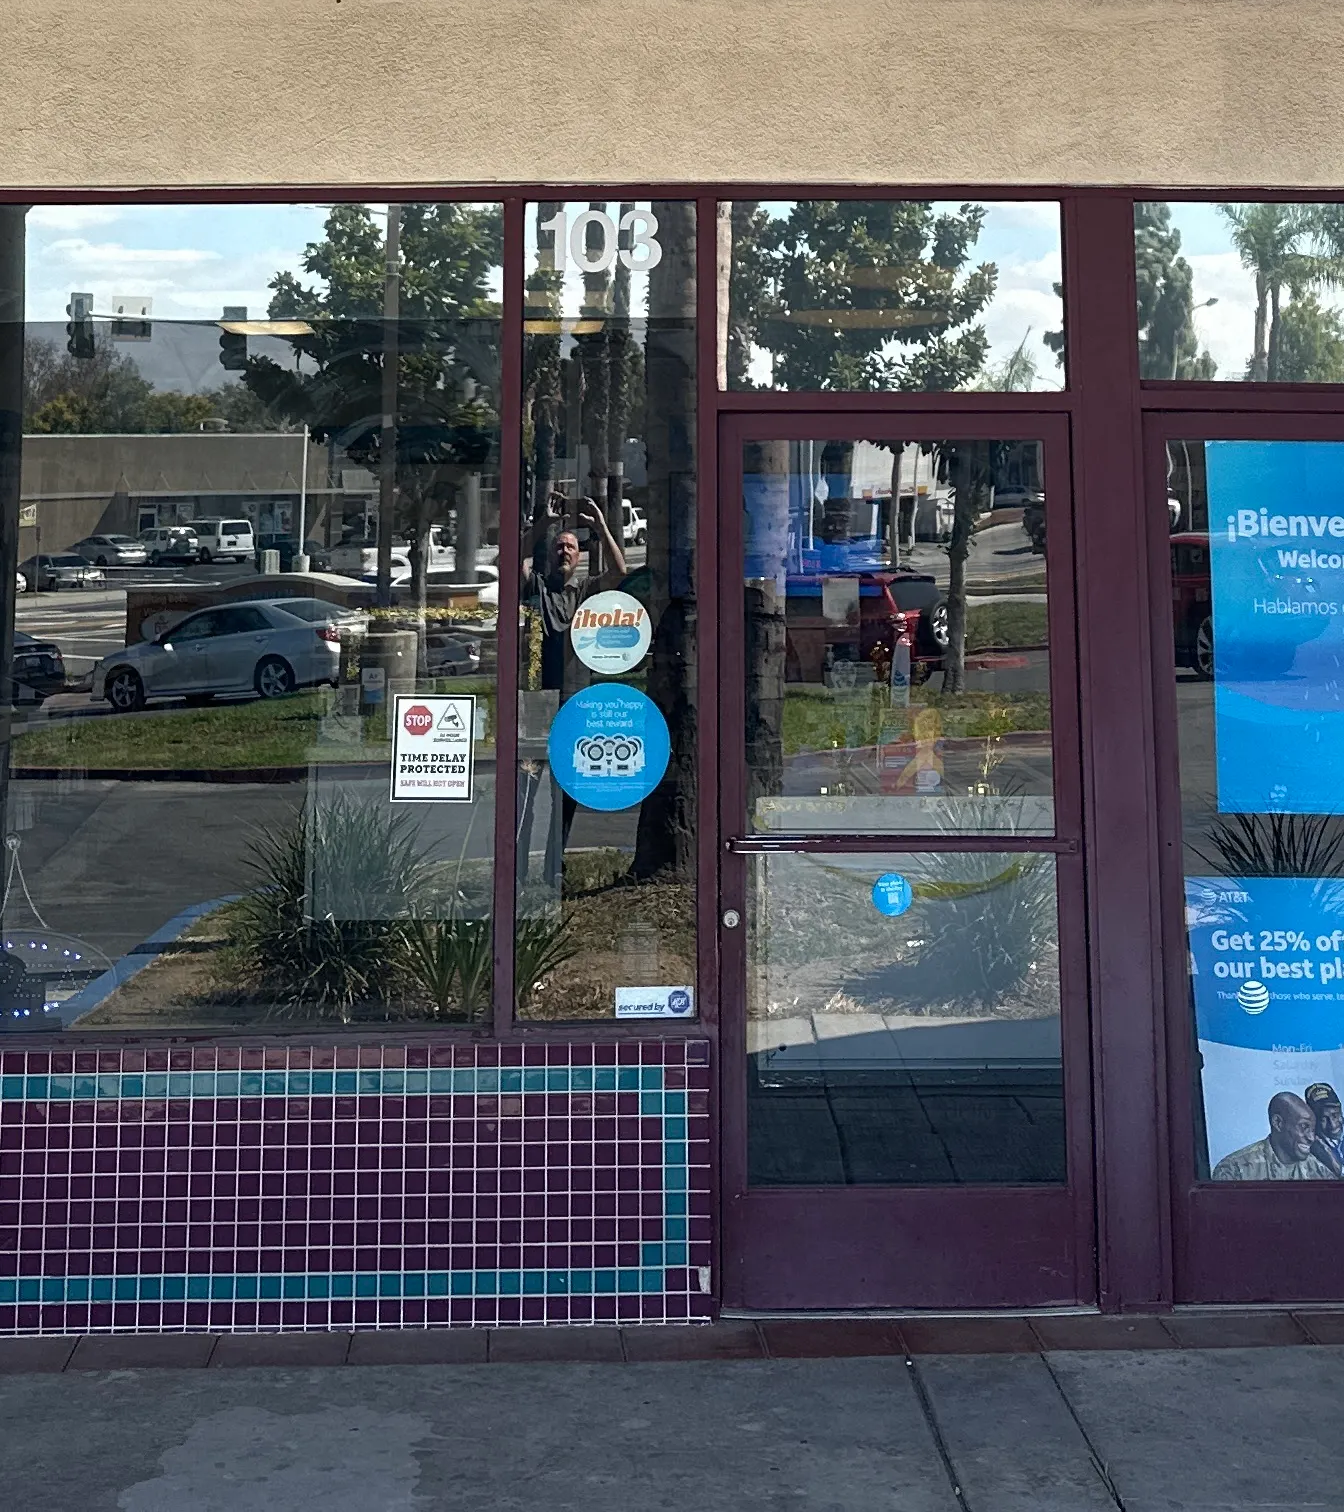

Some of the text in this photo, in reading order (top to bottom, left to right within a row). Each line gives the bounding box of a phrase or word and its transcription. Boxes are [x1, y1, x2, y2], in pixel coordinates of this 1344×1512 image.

[540, 209, 663, 273] 103
[1253, 595, 1338, 615] Hablamos
[573, 607, 645, 630] ¡hola!
[604, 701, 619, 709] you
[620, 699, 644, 711] happy
[405, 714, 432, 727] STOP
[400, 753, 467, 763] TIME DELAY
[399, 764, 466, 774] PROTECTED
[1218, 891, 1249, 903] AT&T
[1211, 930, 1256, 952] Get
[1259, 930, 1311, 952] 25%
[1213, 962, 1255, 979] our
[1259, 956, 1315, 980] best
[1269, 991, 1292, 1001] those
[1293, 991, 1310, 1001] who
[617, 1002, 654, 1012] secured
[655, 1003, 666, 1012] by
